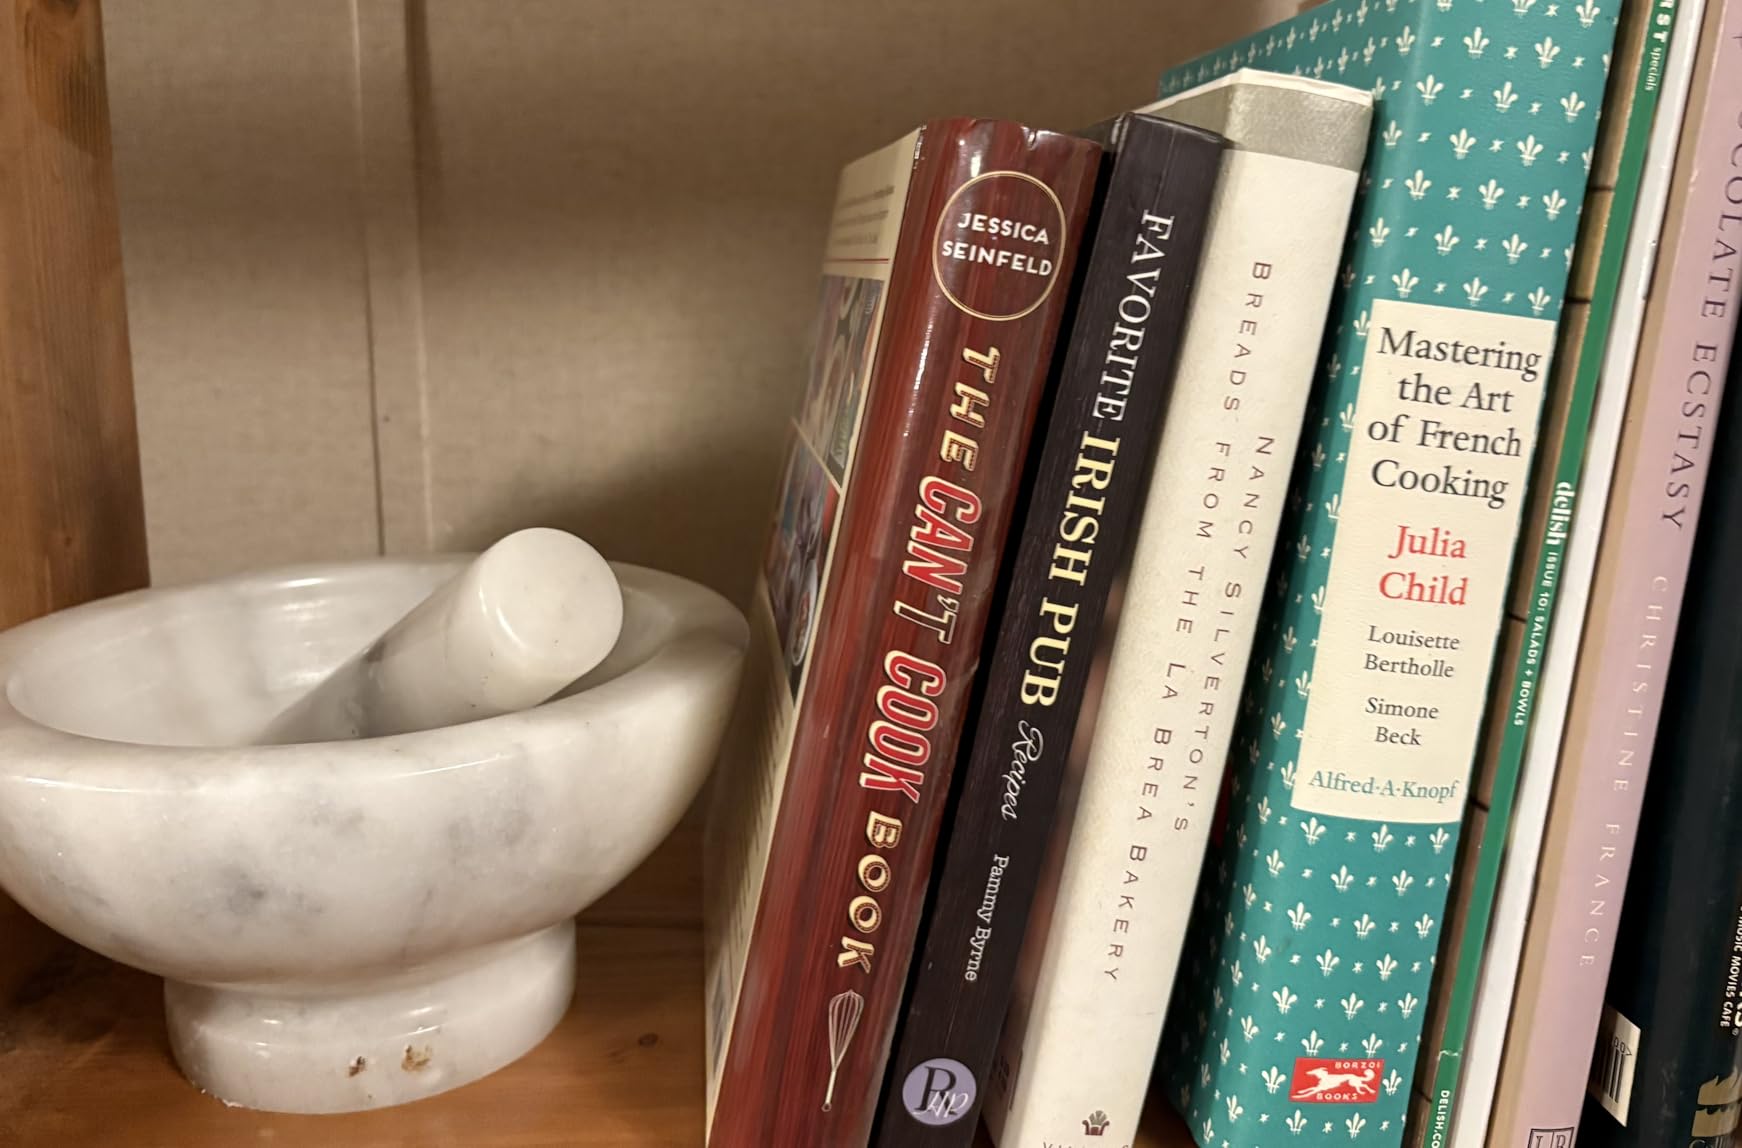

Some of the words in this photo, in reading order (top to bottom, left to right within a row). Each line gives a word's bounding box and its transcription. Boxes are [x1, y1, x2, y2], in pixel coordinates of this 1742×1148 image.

[1645, 47, 1662, 91] specials
[958, 212, 1050, 245] JESSICA
[941, 240, 1053, 277] SEINFELD
[1093, 209, 1175, 422] FAVORITE
[1223, 261, 1272, 412] BREADS
[1376, 327, 1542, 382] Mastering
[940, 346, 1001, 471] THE
[1397, 373, 1453, 406] the
[1459, 382, 1514, 413] Art
[1367, 414, 1411, 442] of
[1416, 419, 1523, 457] French
[1661, 343, 1718, 528] ECSTASY
[1048, 430, 1121, 587] IRISH
[1197, 441, 1231, 540] FROM
[1232, 435, 1275, 559] NANCY
[1371, 458, 1509, 509] Cooking
[1546, 481, 1575, 546] delish
[893, 475, 982, 644] CAN'T
[1387, 525, 1467, 559] Julia
[1378, 570, 1469, 607] Child
[1541, 552, 1558, 588] ISSUE
[1176, 565, 1205, 634] THE
[1020, 597, 1079, 708] PUB
[1367, 624, 1460, 651] Louisette
[1526, 615, 1545, 665] SALADS
[1162, 661, 1187, 701] LA
[1364, 654, 1455, 679] Bertholle
[1613, 575, 1669, 792] CHRISTINE
[858, 649, 947, 803] COOK
[1173, 580, 1242, 832] SILVERTON'S
[1365, 696, 1439, 720] Simone
[1514, 680, 1532, 726] BOWLS
[1375, 726, 1422, 747] Beck
[1001, 720, 1045, 821] Recipes
[1136, 727, 1173, 822] BREA
[838, 811, 903, 974] BOOK
[976, 854, 1010, 923] Pammy
[1103, 844, 1147, 982] BAKERY
[1579, 823, 1620, 967] FRANCE
[965, 925, 991, 981] Byrne
[1725, 955, 1742, 998] MOVIES
[1720, 1001, 1734, 1027] CAFE
[1335, 1061, 1380, 1069] BORZOI
[1316, 1092, 1358, 1100] BOOKS
